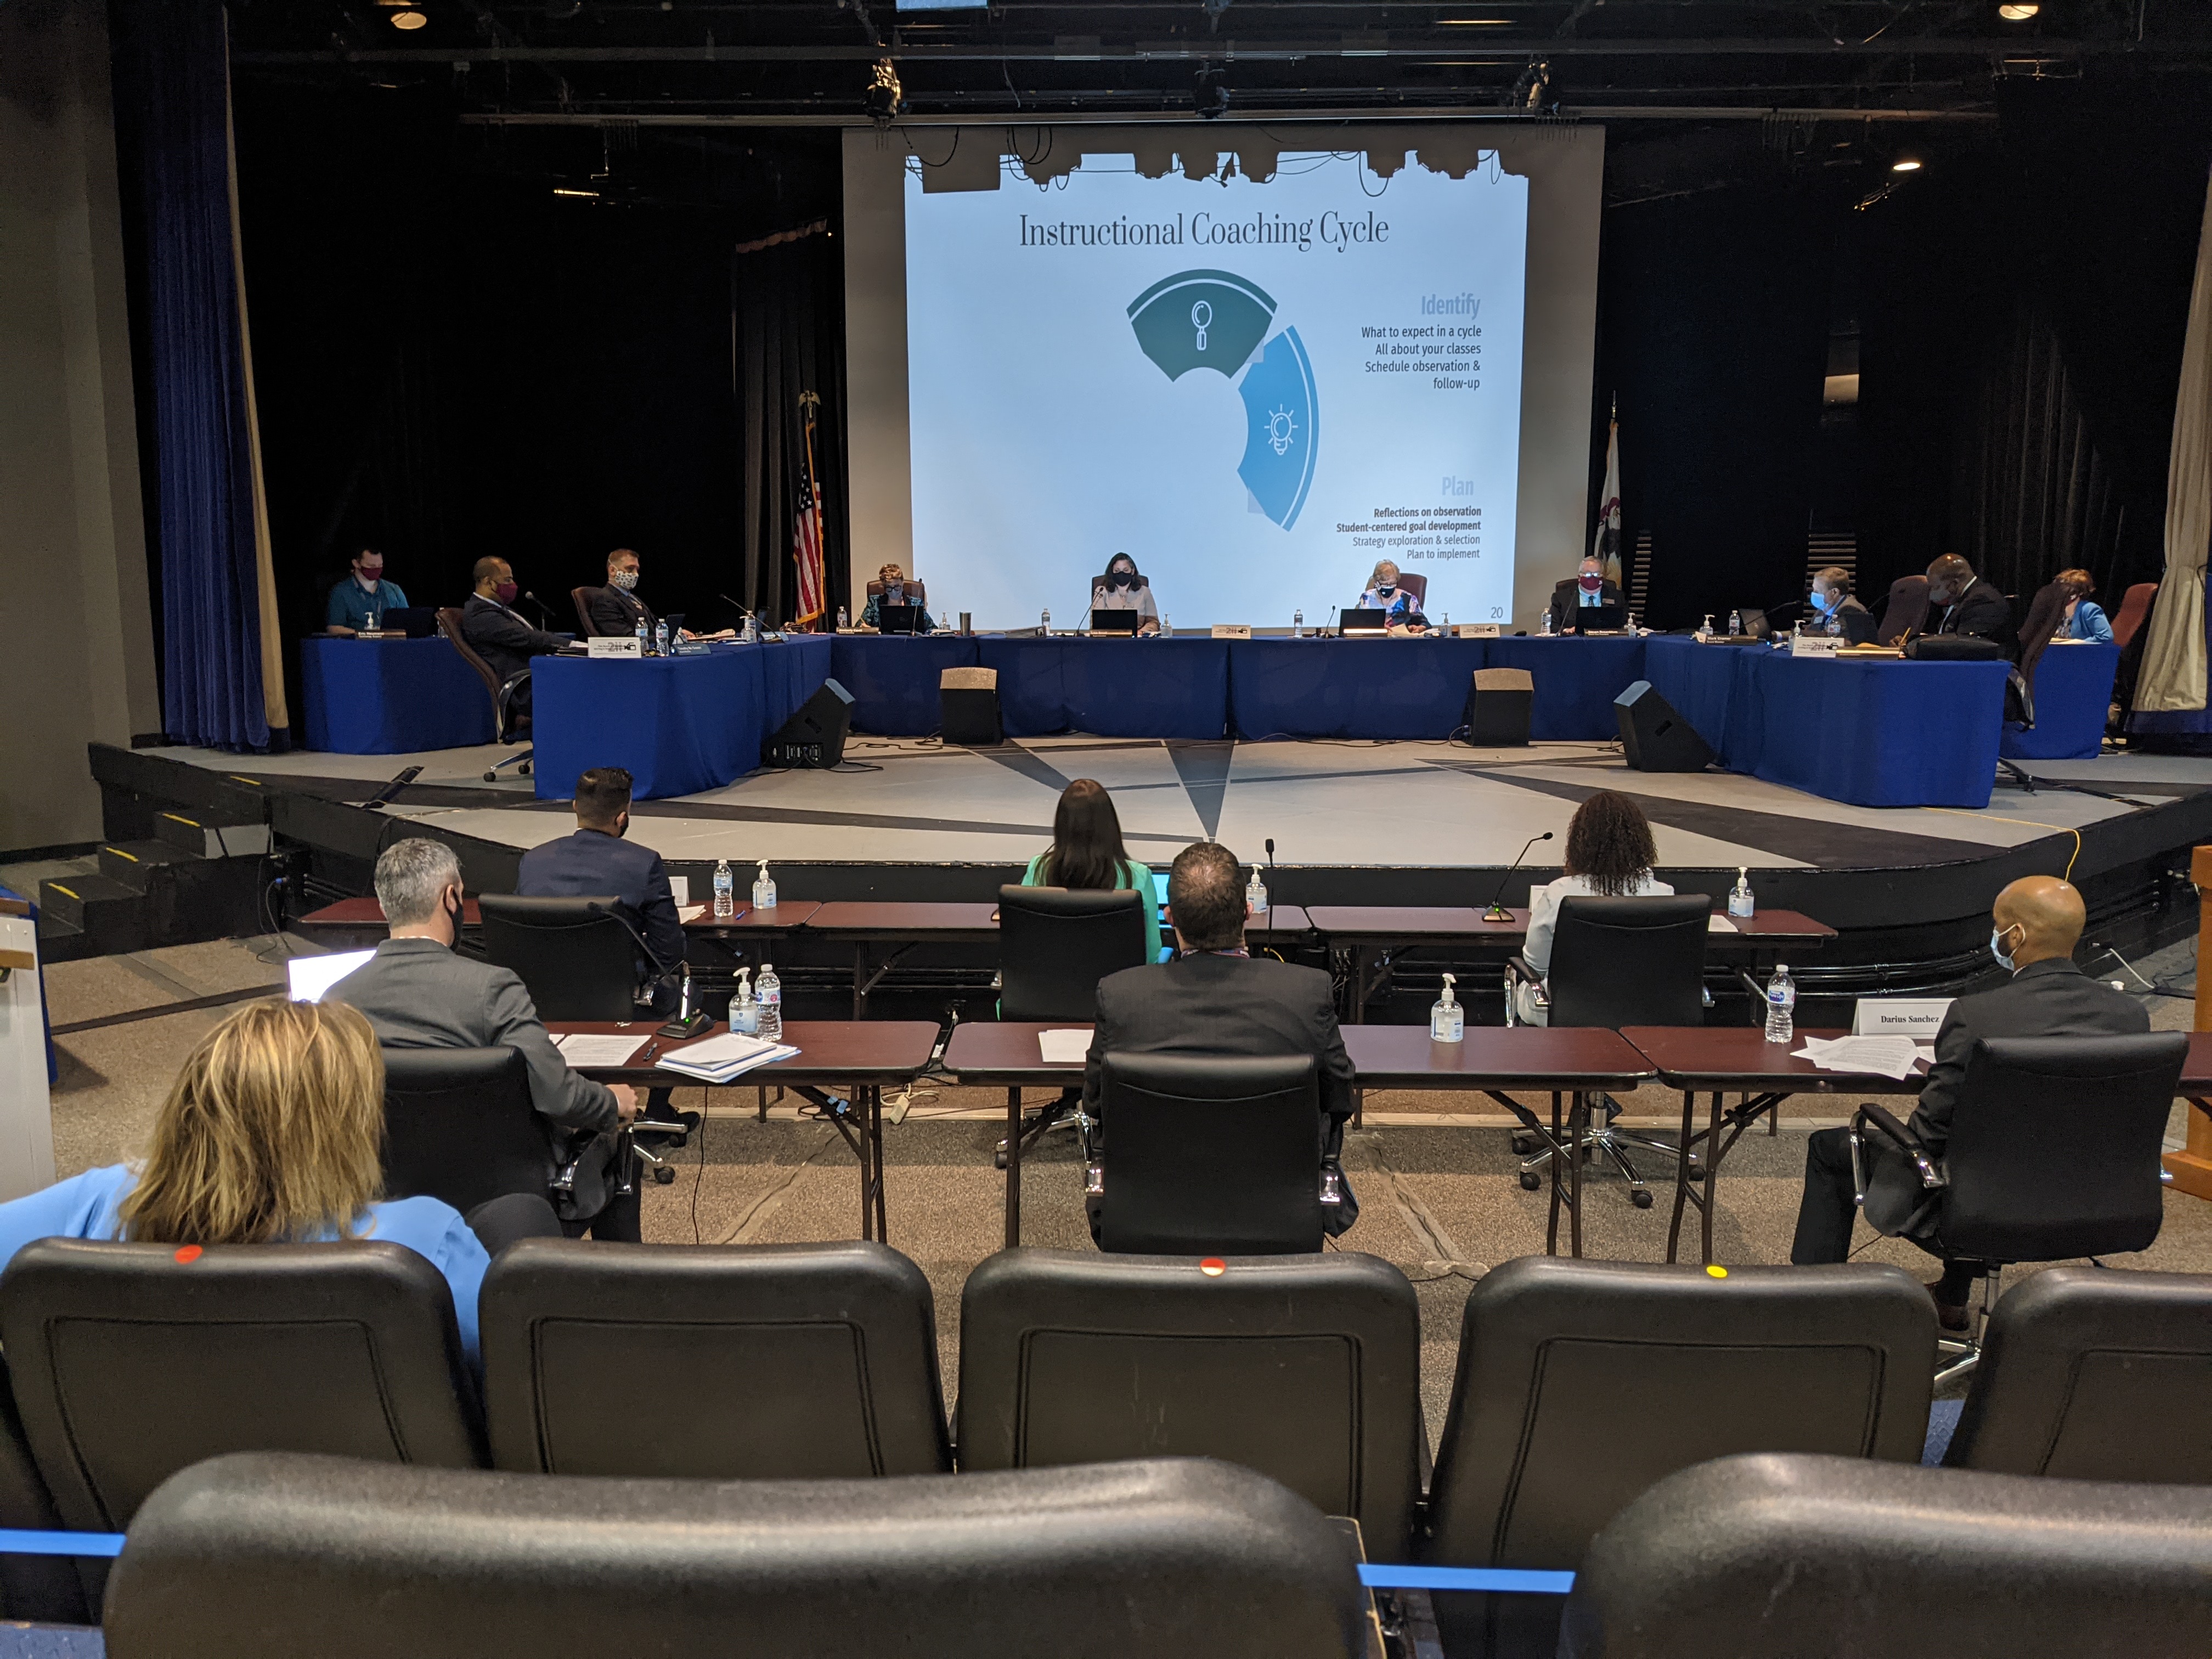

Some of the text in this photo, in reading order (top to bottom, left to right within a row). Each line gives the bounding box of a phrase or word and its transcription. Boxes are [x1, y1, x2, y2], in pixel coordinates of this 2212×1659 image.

[1020, 210, 1389, 253] Instructional Coaching Cycle
[1421, 292, 1481, 321] Identify
[1362, 325, 1482, 340] What to expect in a cycle
[1375, 342, 1481, 358] All about your classes
[1365, 359, 1481, 373] Schedule observation &
[1433, 377, 1480, 391] follow-up
[1442, 476, 1474, 496] Plan
[1374, 505, 1481, 518] Reflections on observation
[1336, 520, 1481, 533] Student-centered goal development
[1352, 534, 1480, 548] Strategy exploration & selection
[1407, 549, 1480, 561] Plan to implement
[1491, 606, 1503, 619] 20
